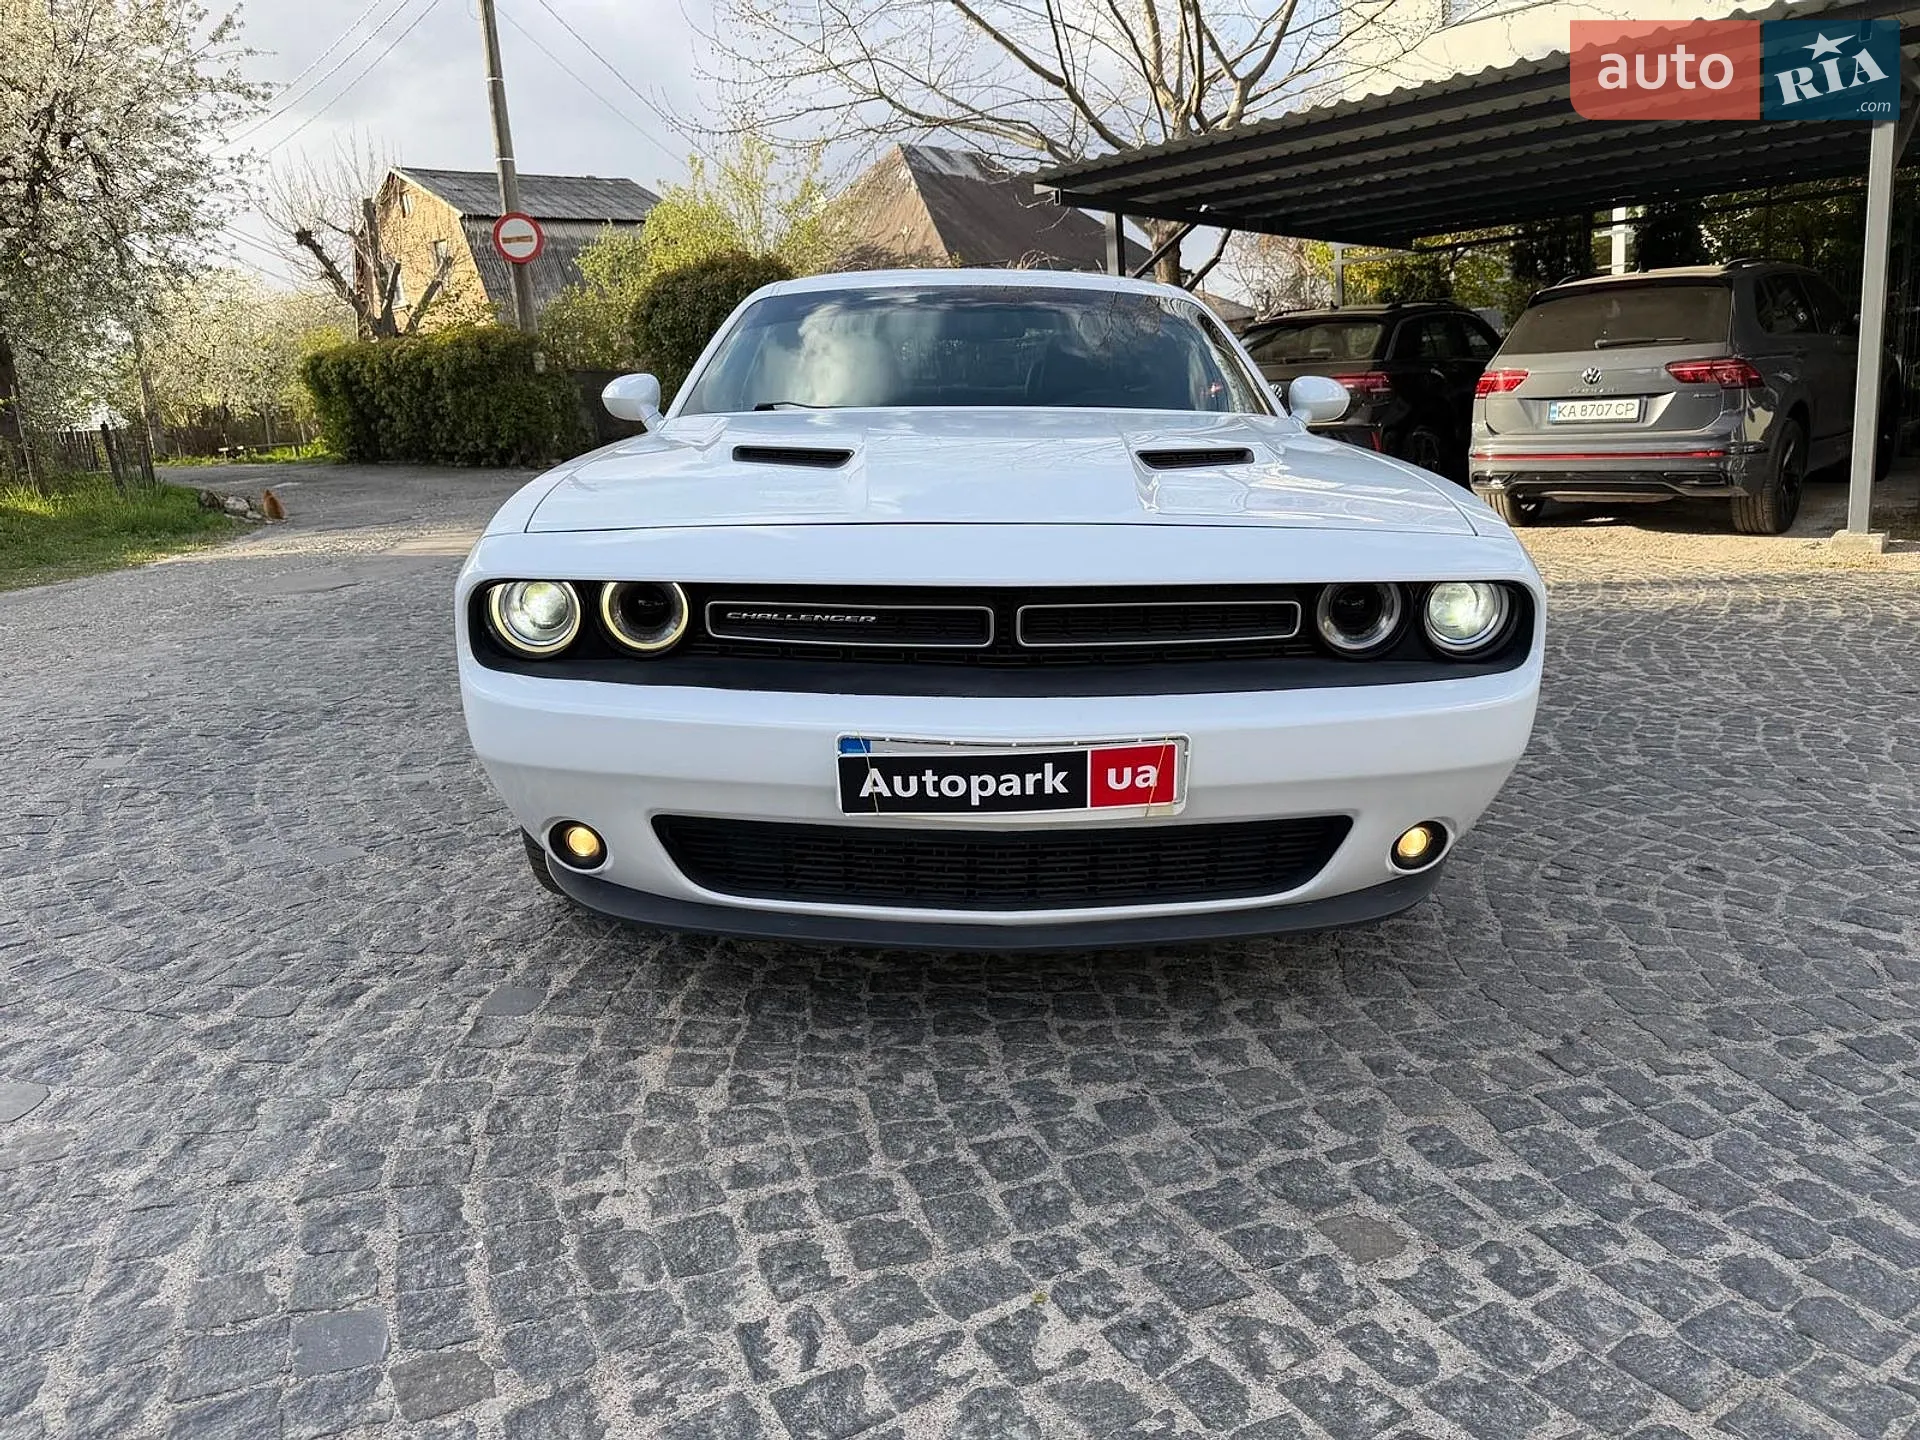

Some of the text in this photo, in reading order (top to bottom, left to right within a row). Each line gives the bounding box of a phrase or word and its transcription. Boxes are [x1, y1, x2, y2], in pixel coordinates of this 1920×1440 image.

[1557, 402, 1636, 418] KA 8707 CP
[725, 611, 878, 624] CHALLENGER
[859, 762, 1159, 806] Autopark ua
